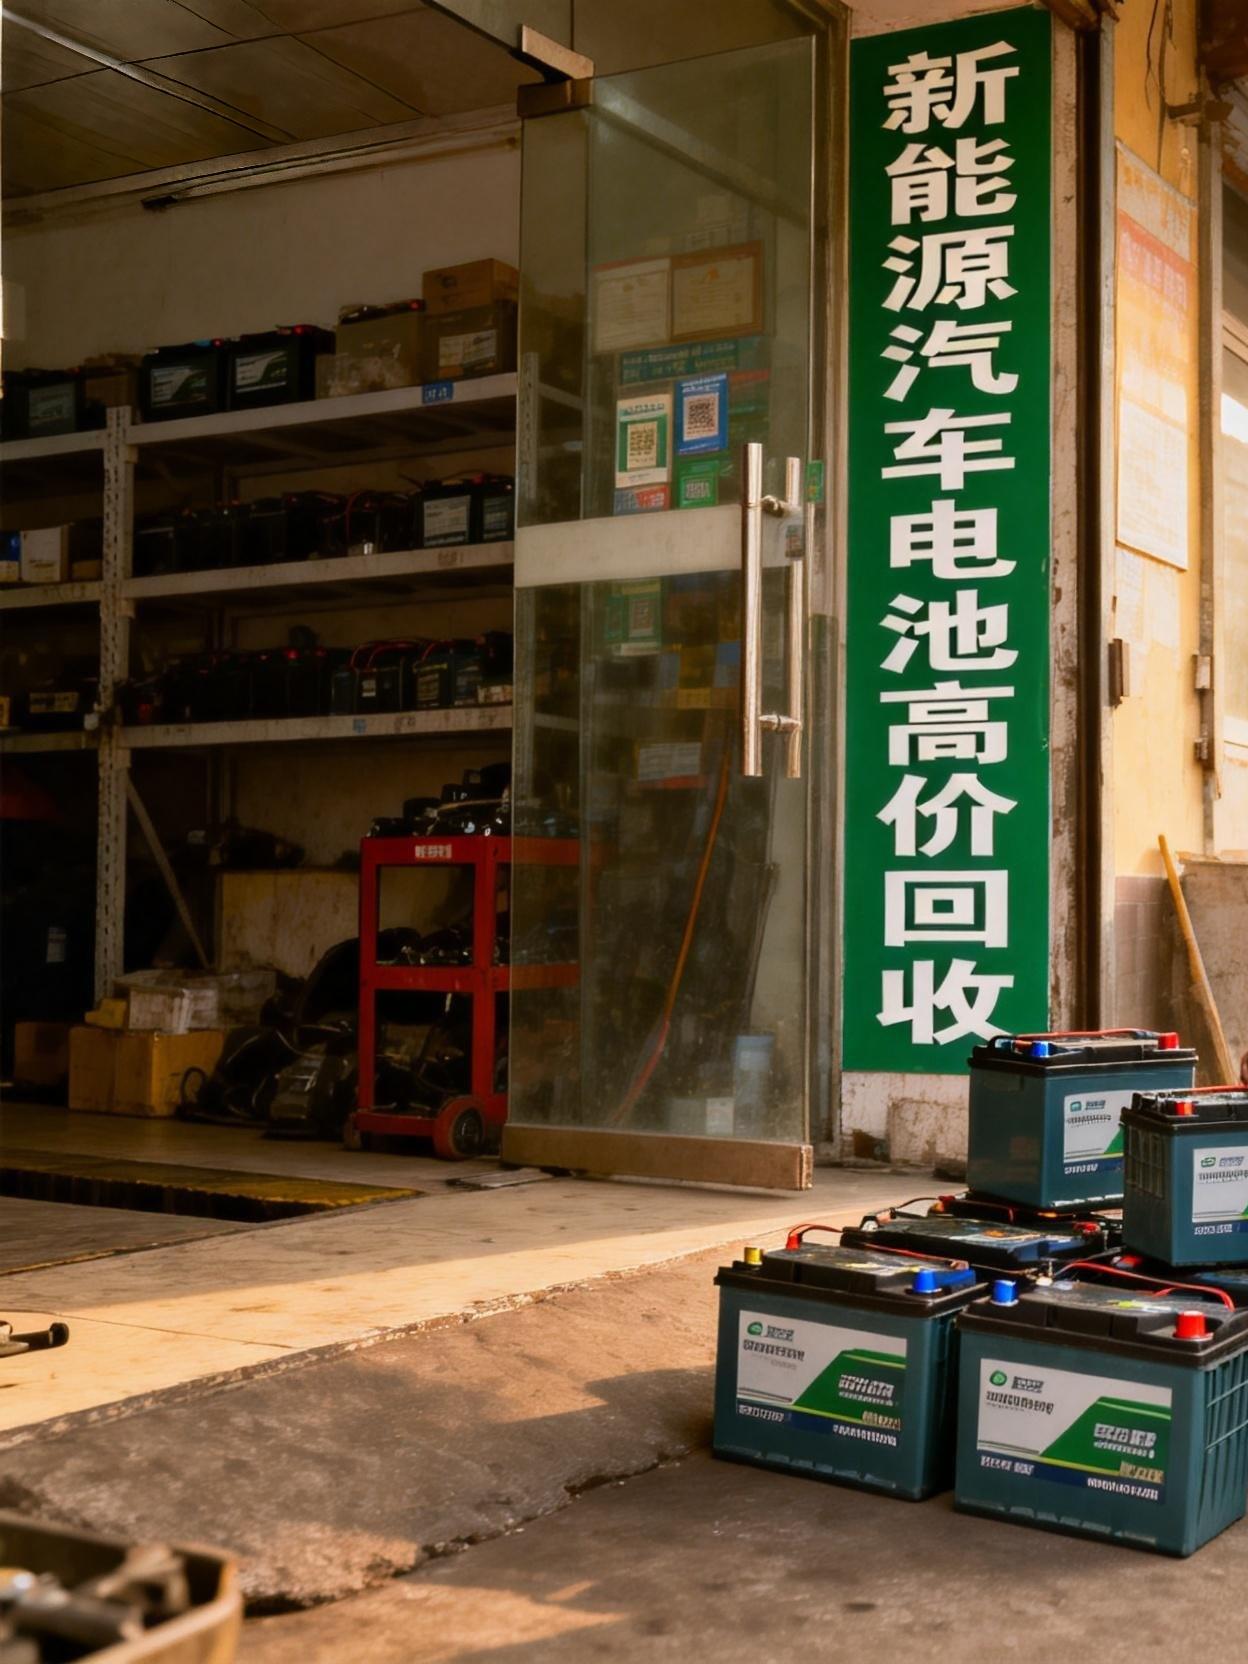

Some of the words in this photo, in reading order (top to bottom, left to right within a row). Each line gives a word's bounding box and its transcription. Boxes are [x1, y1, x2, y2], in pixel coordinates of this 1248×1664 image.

[877, 41, 1020, 1046] 新能源汽车电池高价回收
